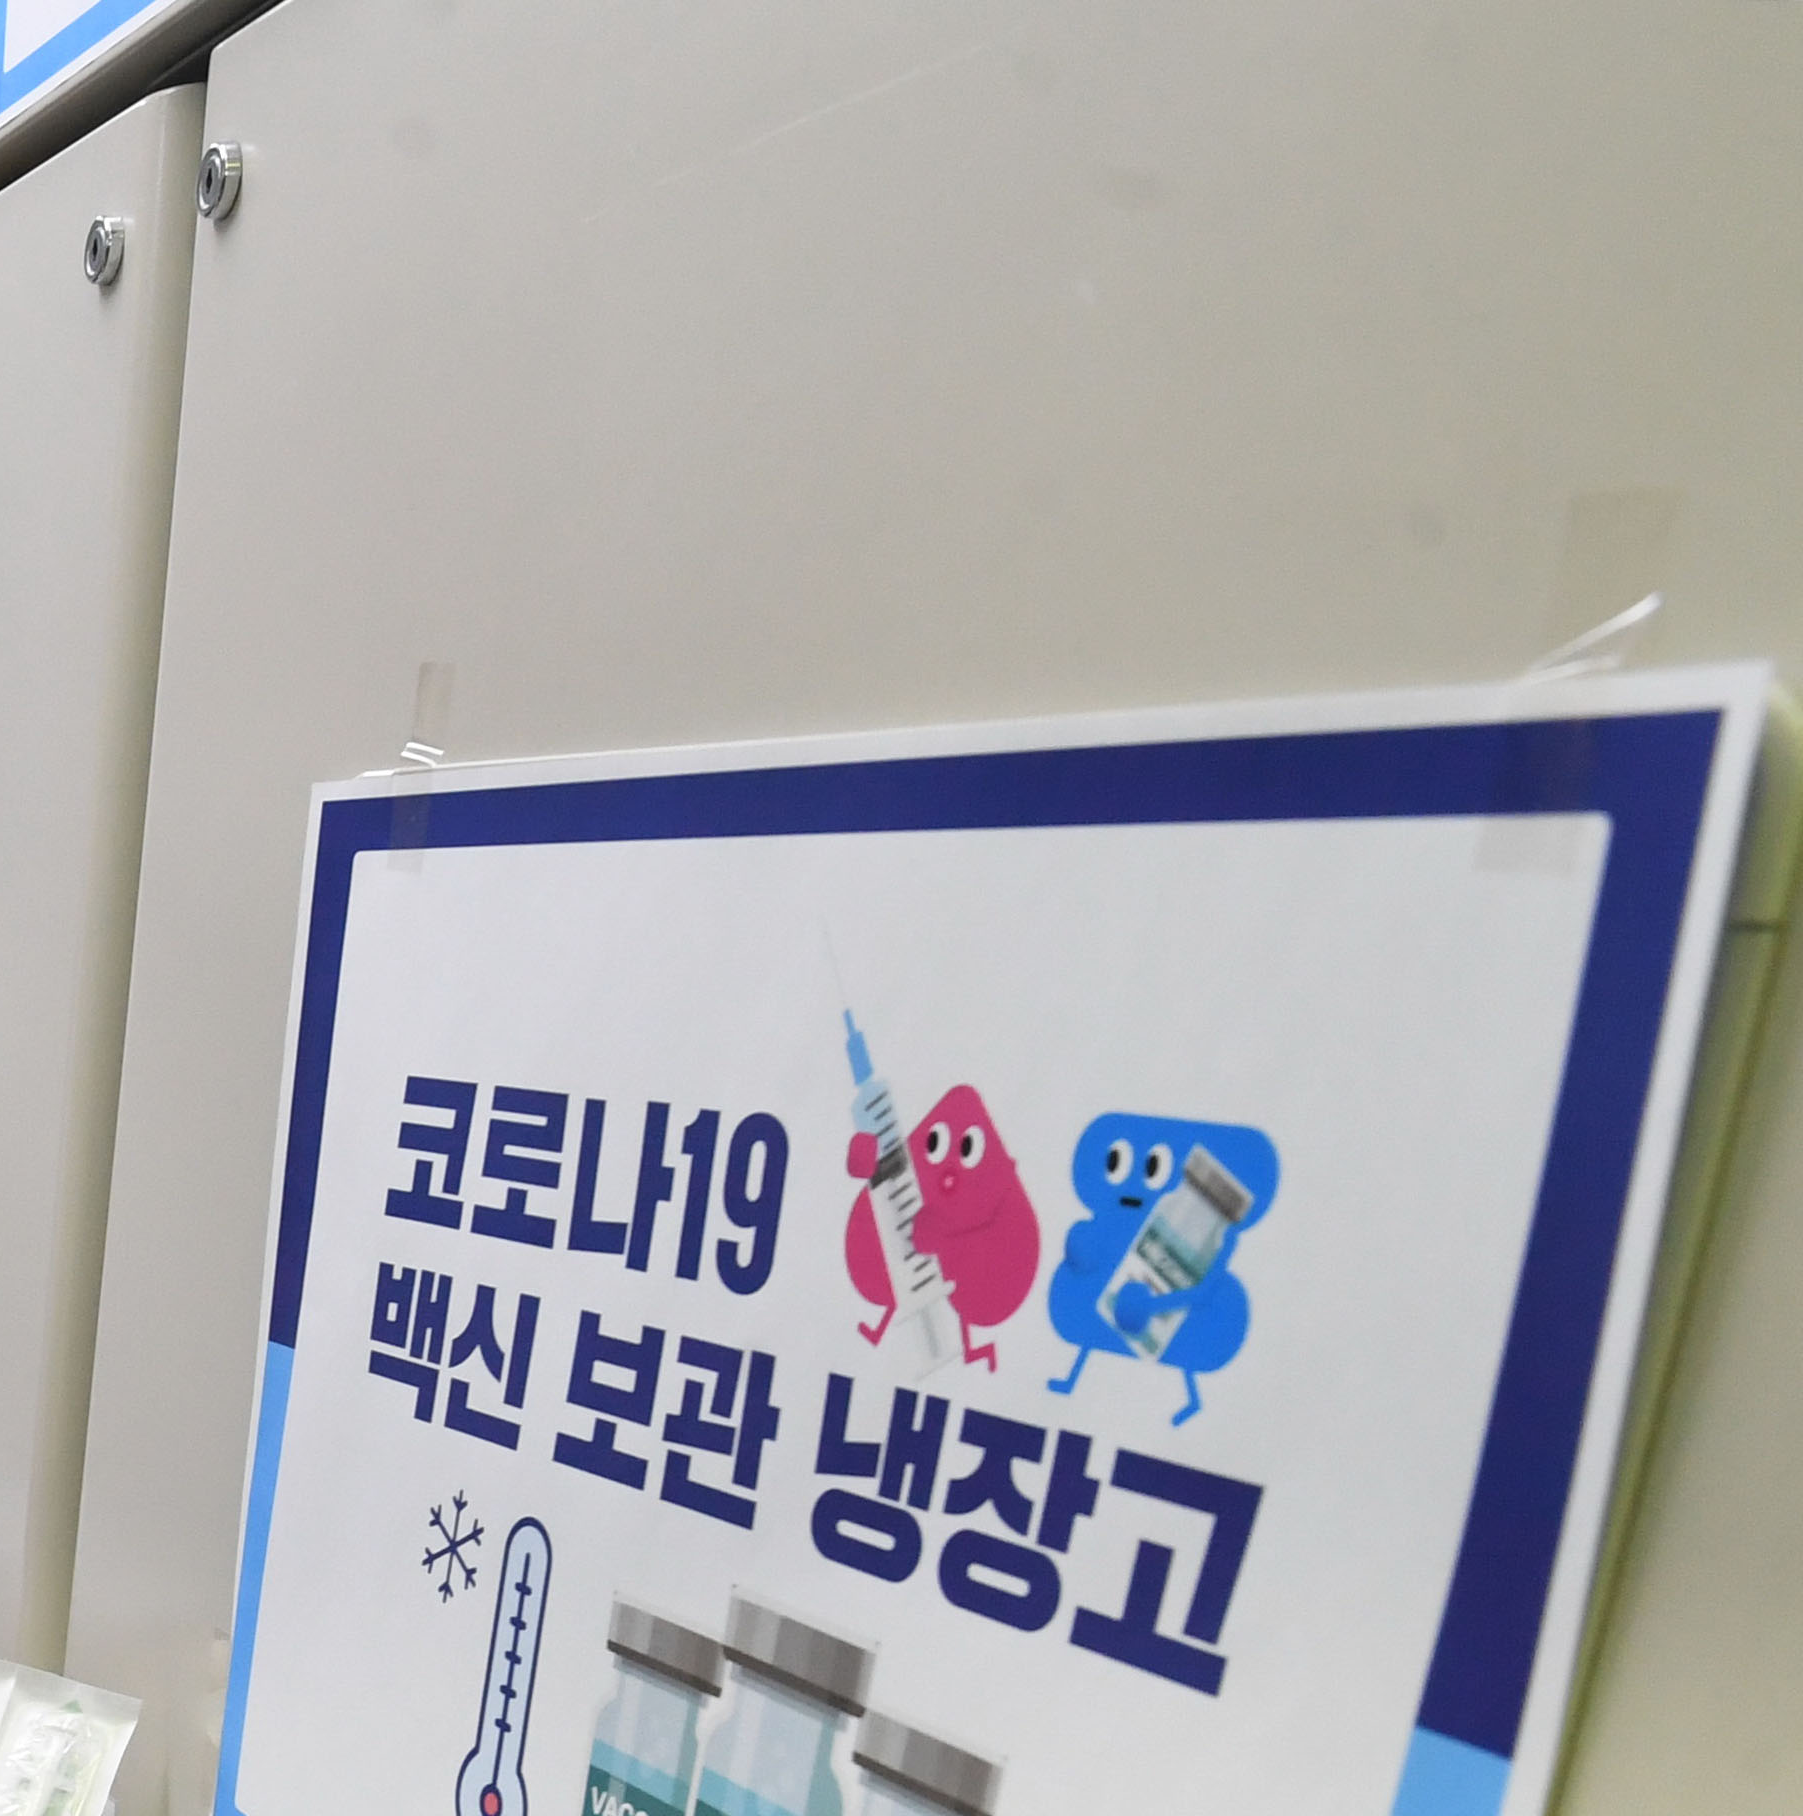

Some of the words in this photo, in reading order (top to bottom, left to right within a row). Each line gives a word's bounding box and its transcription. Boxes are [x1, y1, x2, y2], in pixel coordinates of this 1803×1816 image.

[384, 1074, 791, 1297] 코로나19
[368, 1261, 541, 1452] 백신
[551, 1309, 781, 1532] 보관
[809, 1372, 1265, 1699] 냉장고
